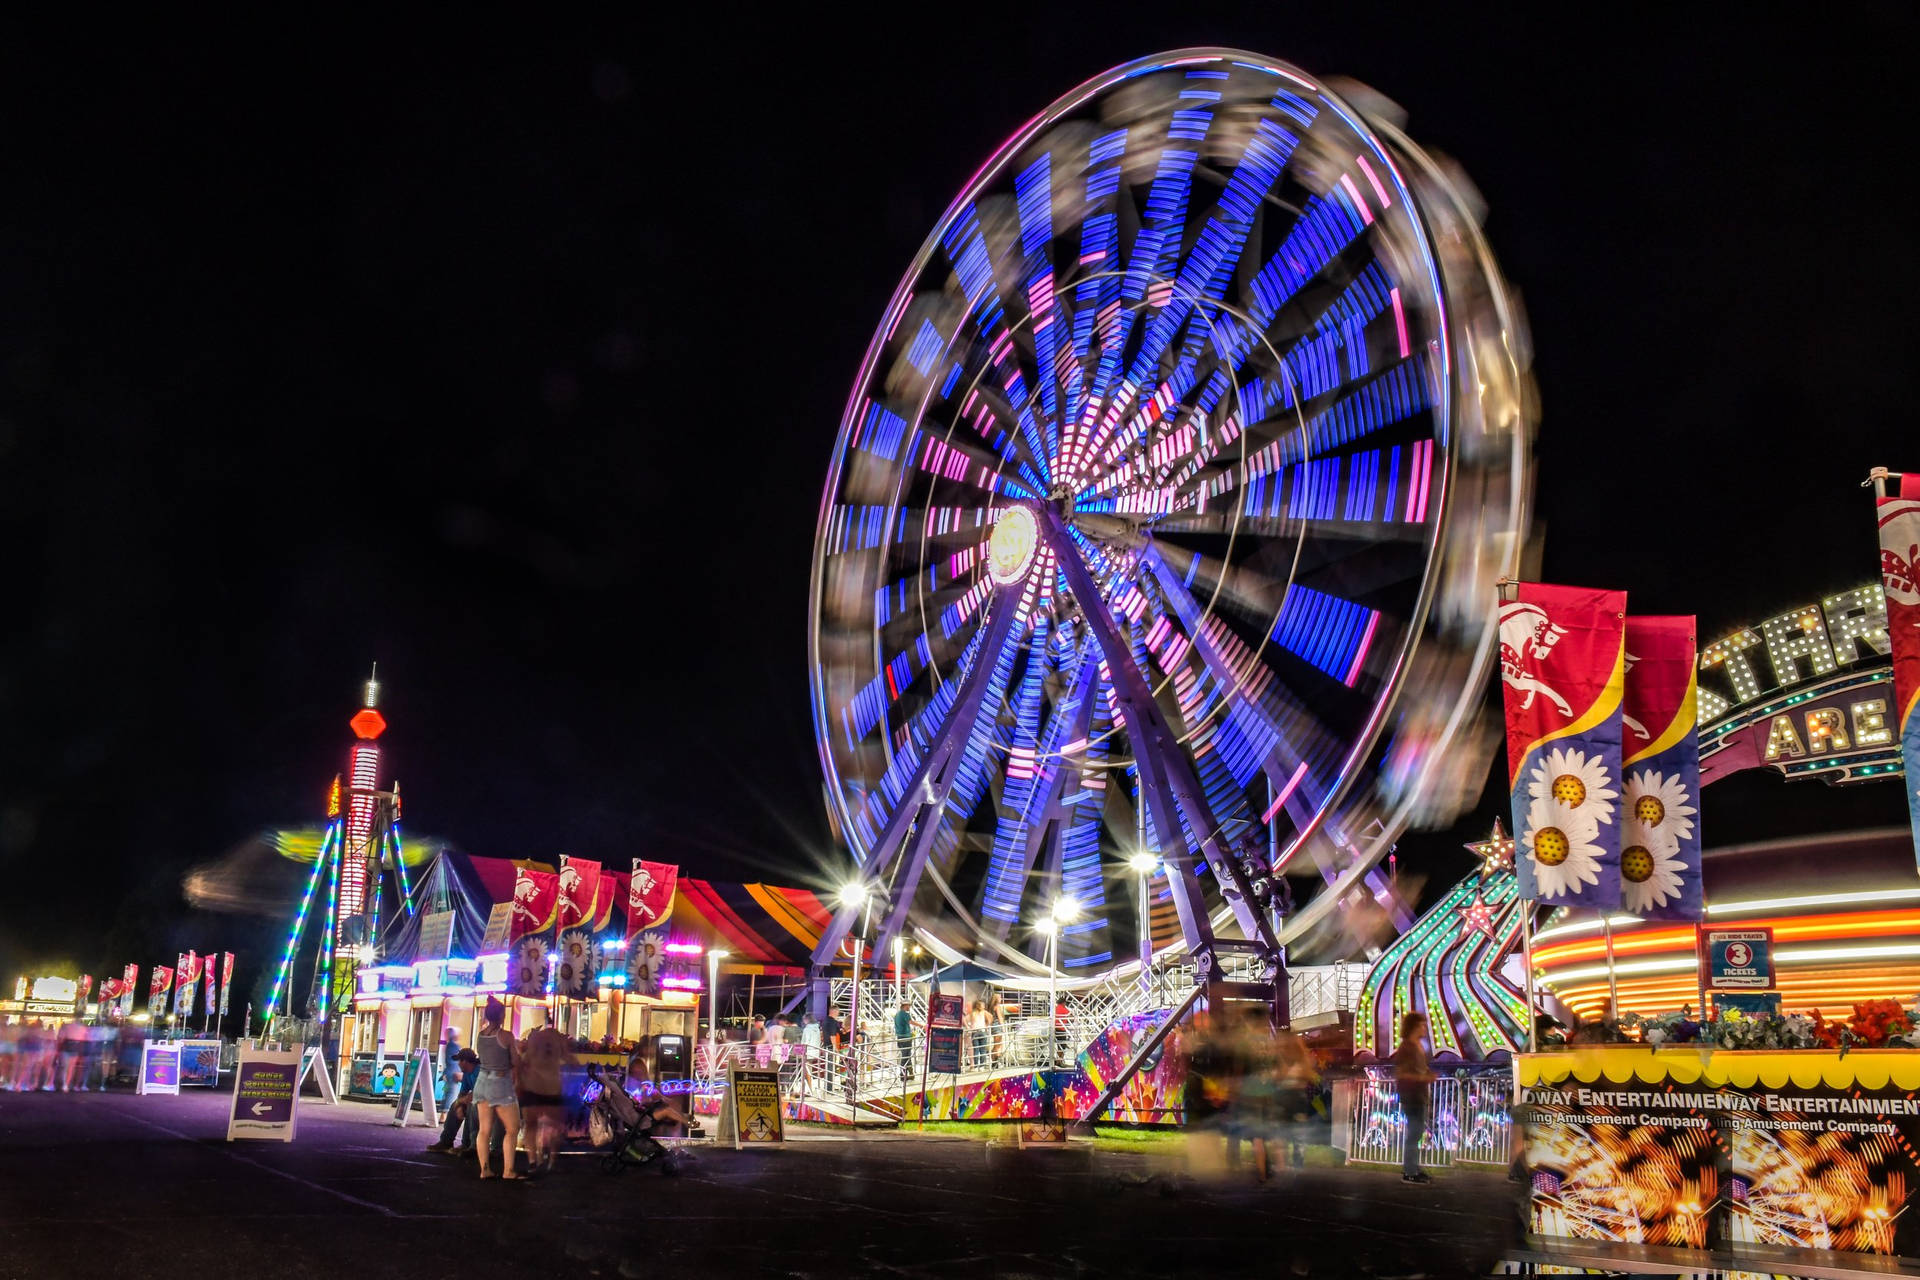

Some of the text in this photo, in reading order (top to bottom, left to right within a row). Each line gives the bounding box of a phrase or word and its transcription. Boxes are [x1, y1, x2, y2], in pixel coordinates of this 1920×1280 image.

[1730, 944, 1748, 965] 3
[1723, 968, 1757, 976] TICKETS
[1556, 1112, 1637, 1125] Amusement
[1640, 1113, 1709, 1131] Company
[1744, 1117, 1823, 1132] Amusement
[1827, 1119, 1897, 1137] Company
